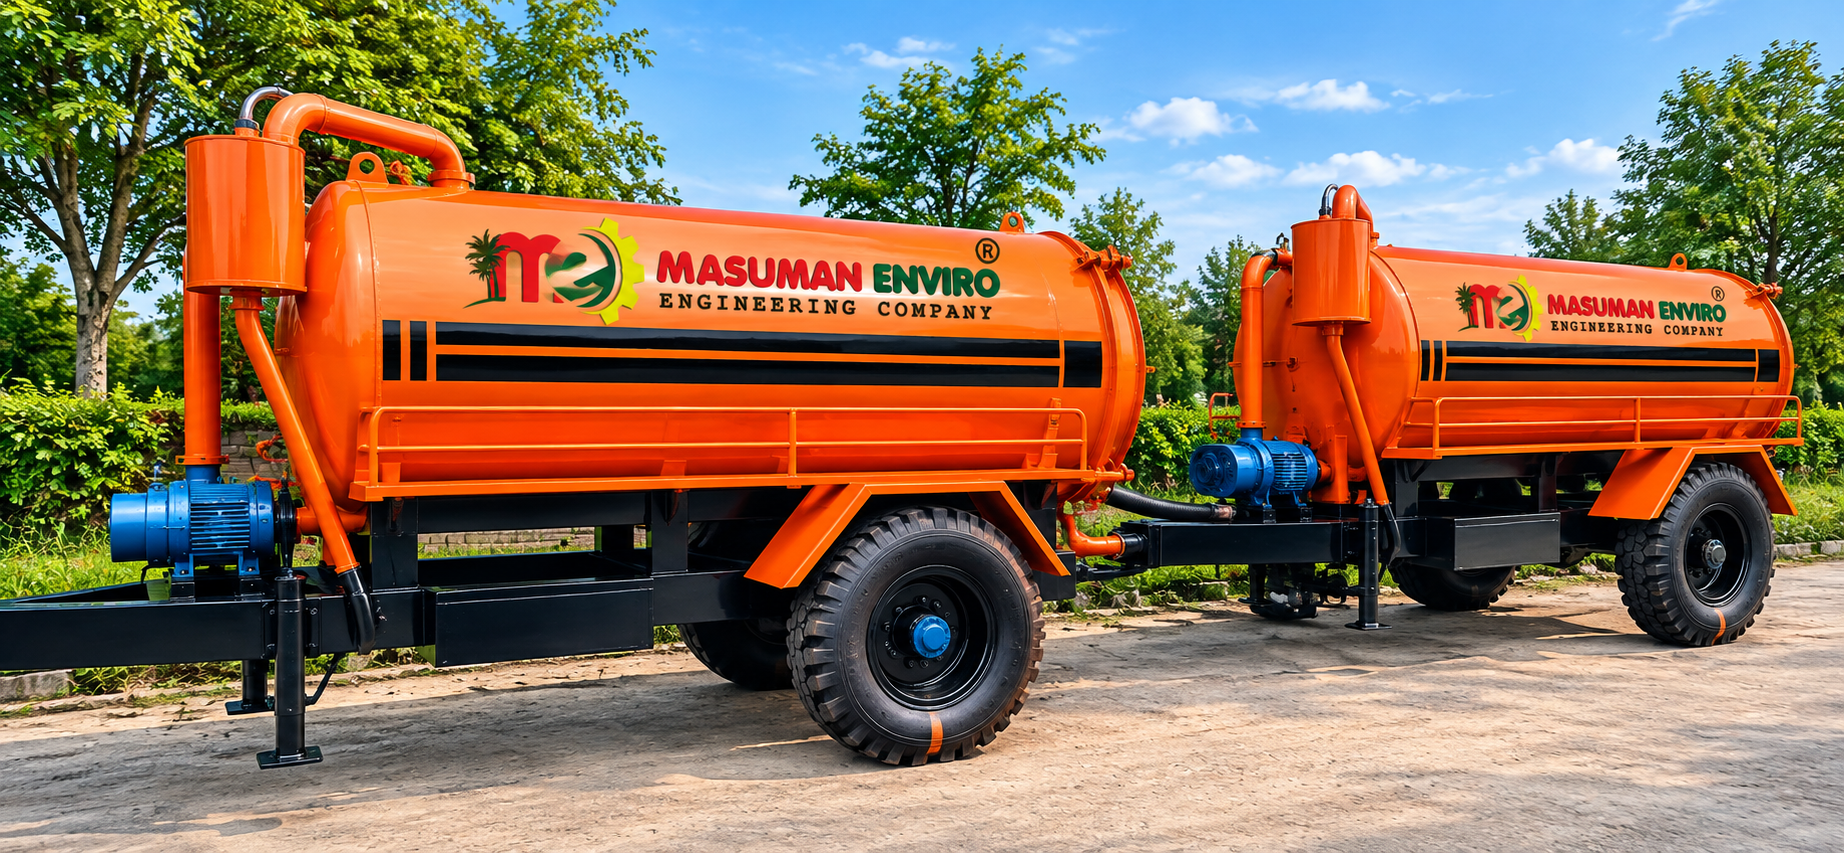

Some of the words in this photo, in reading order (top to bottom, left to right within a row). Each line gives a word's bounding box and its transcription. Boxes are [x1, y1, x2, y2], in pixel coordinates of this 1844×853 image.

[656, 250, 863, 293] MASUMAN
[873, 263, 1001, 298] ENVIRO
[659, 293, 857, 316] ENGINEERING
[877, 301, 993, 320] COMPANY
[1547, 294, 1655, 320] MASUMAN
[1659, 300, 1727, 323] ENVIRO
[1551, 320, 1653, 335] ENGINEERING
[1663, 324, 1724, 337] COMPANY
